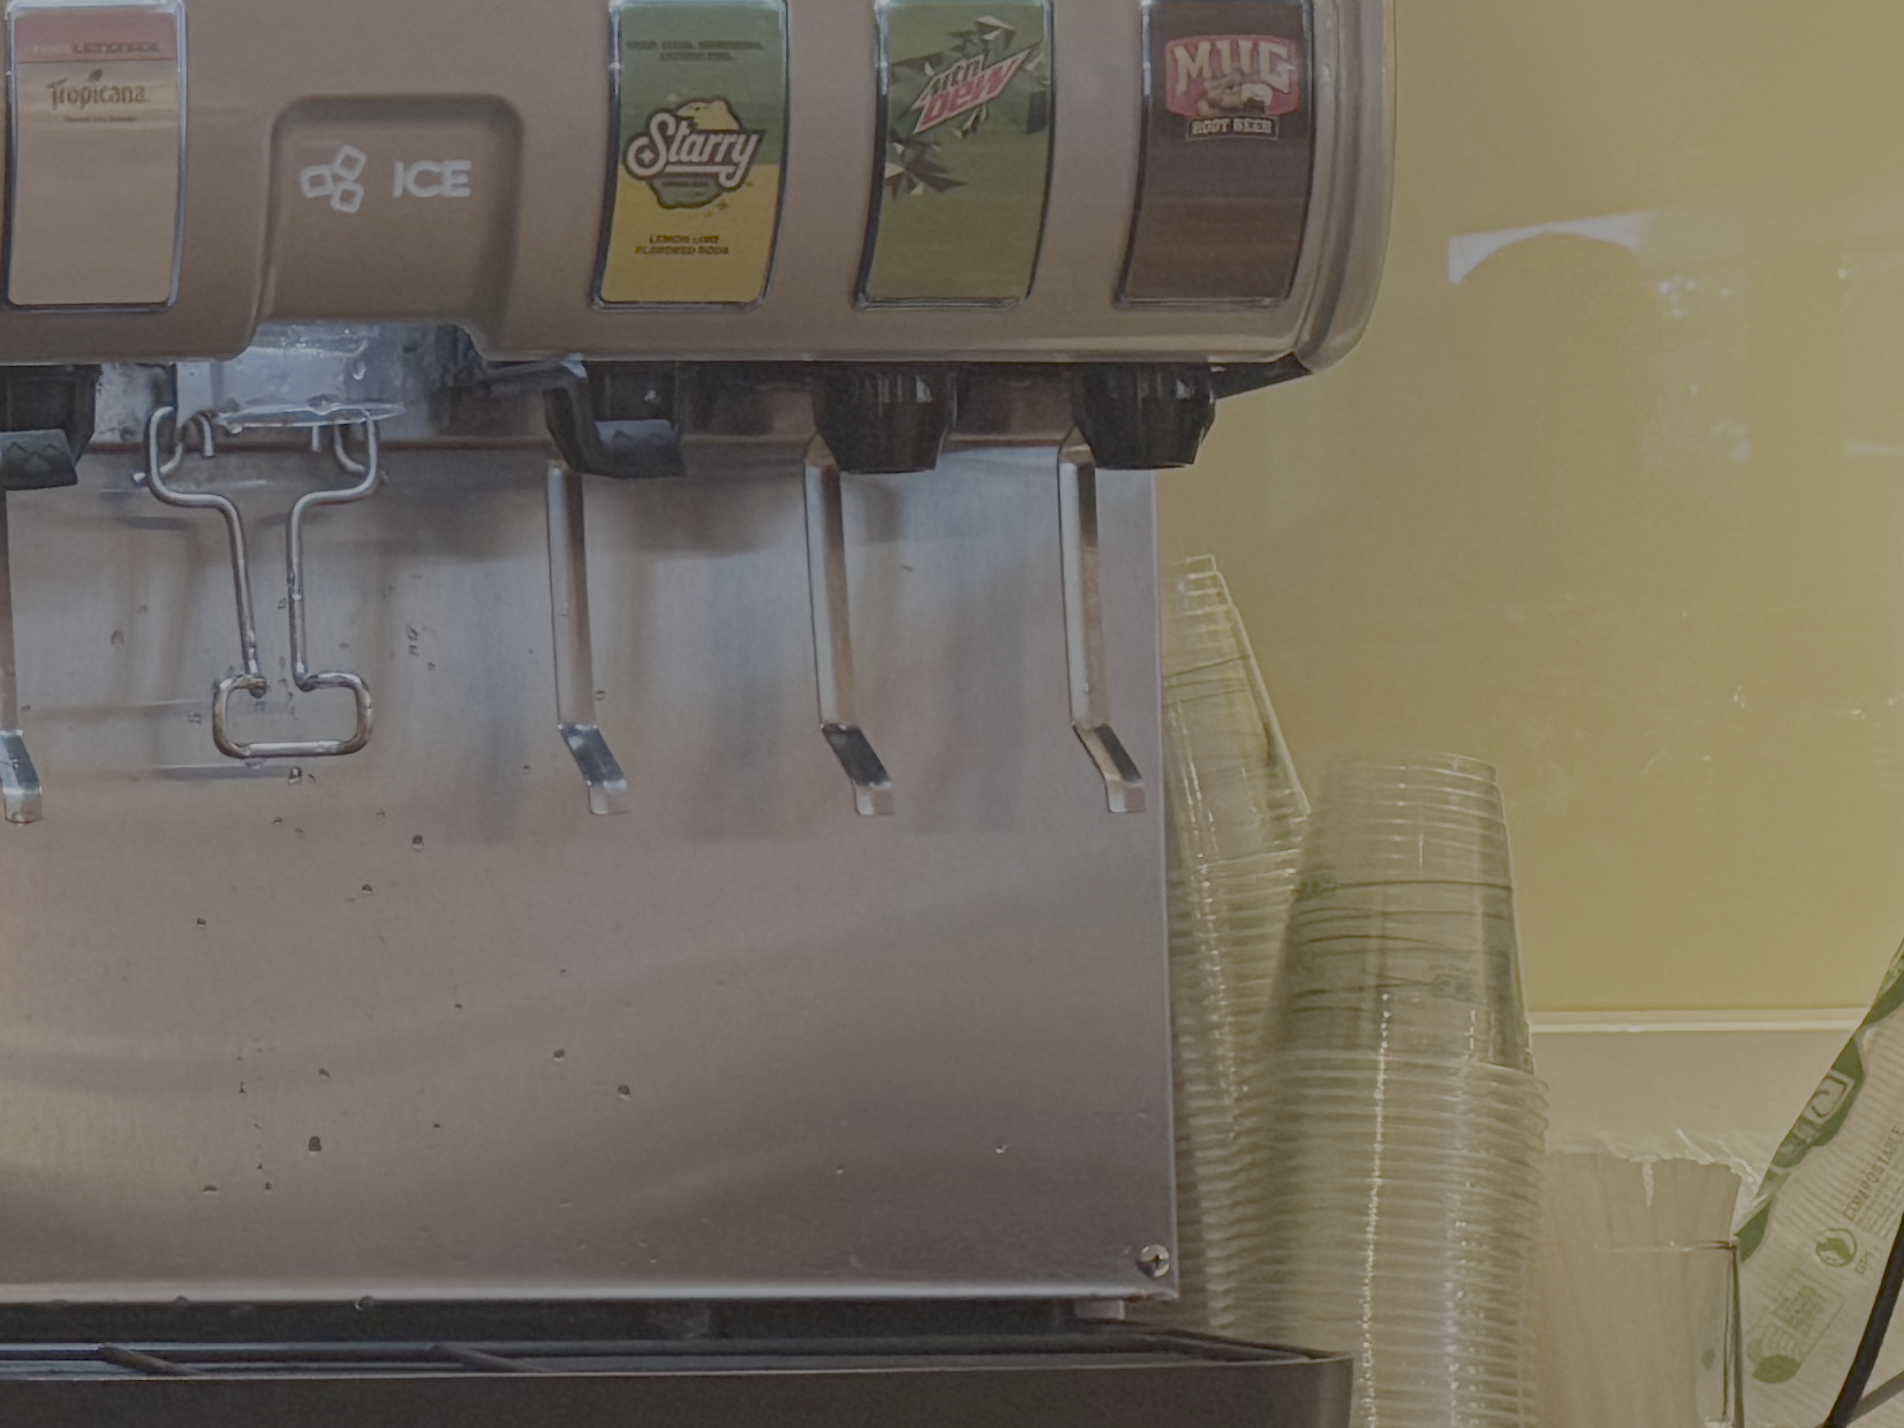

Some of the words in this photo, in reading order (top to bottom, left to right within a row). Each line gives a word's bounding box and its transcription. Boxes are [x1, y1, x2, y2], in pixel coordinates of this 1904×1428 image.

[1173, 38, 1296, 97] MUG
[46, 77, 148, 111] Tropicana
[625, 111, 761, 189] Starry
[392, 159, 473, 200] ICE
